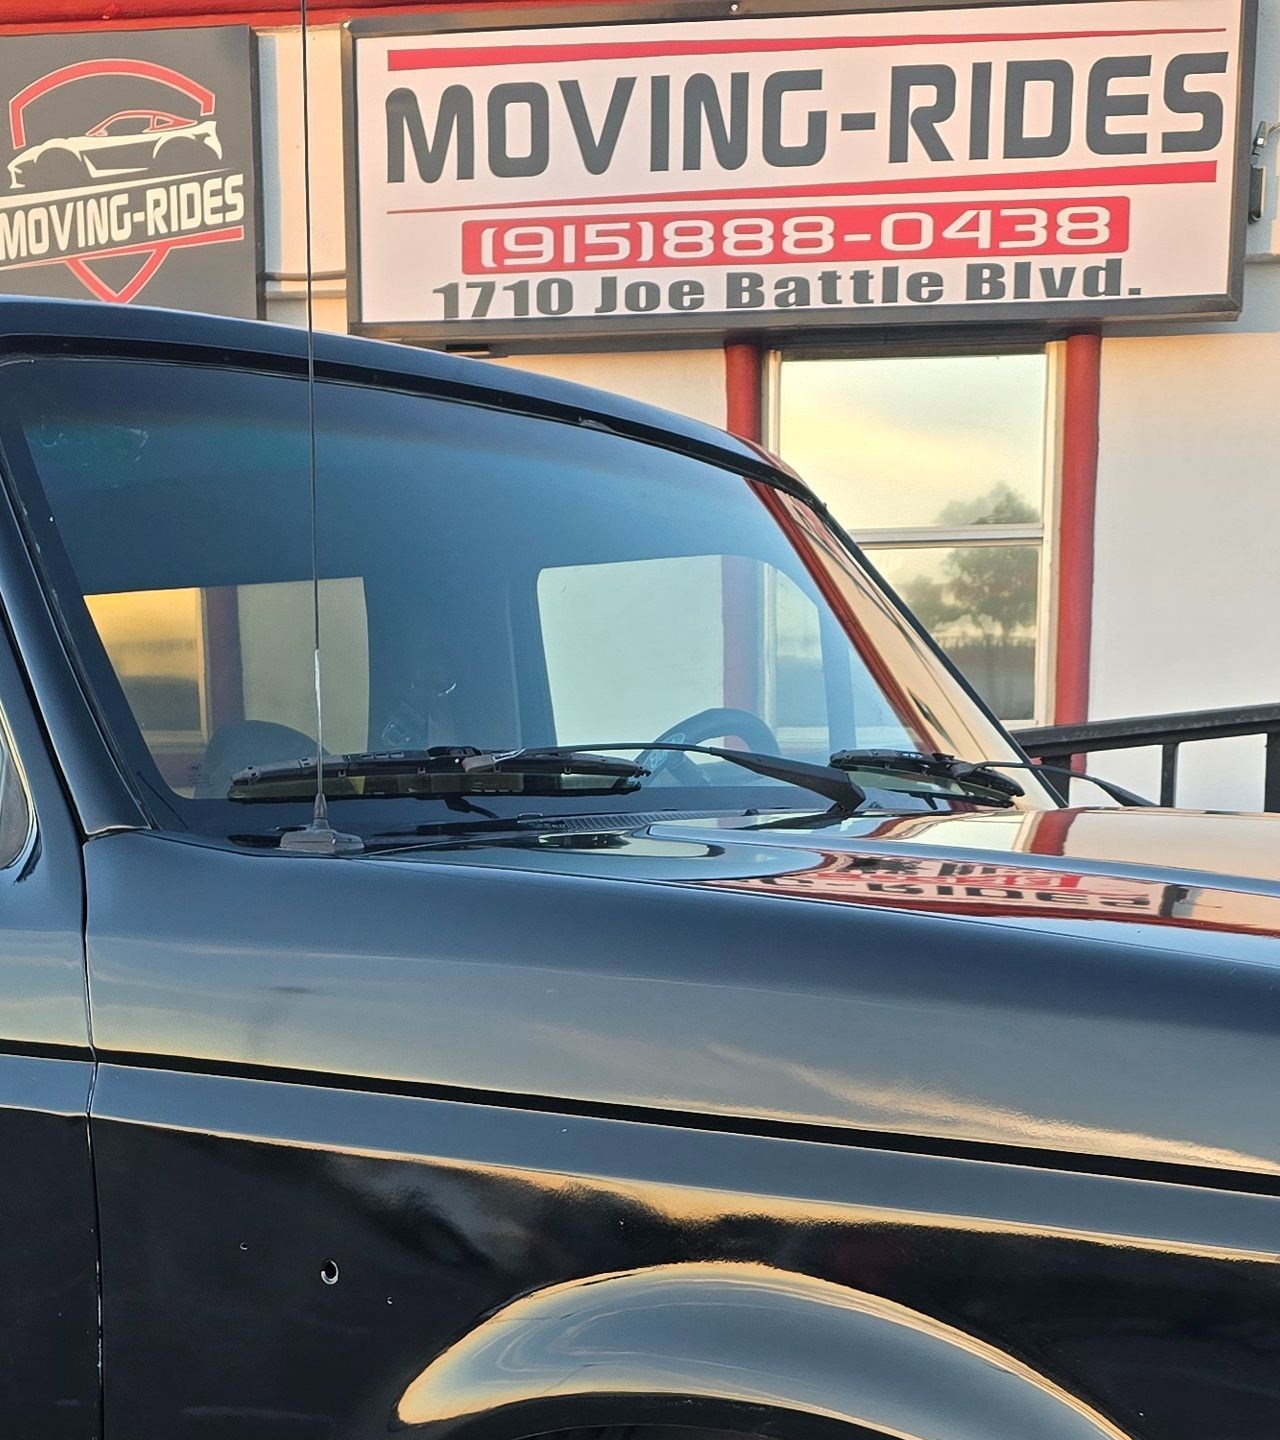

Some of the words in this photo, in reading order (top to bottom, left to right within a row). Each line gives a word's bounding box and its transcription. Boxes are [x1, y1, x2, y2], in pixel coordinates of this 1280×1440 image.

[385, 51, 1229, 184] MOVING-RIDES
[480, 207, 1112, 266] (915)888-0438
[431, 279, 574, 320] 1710
[593, 273, 706, 314] Joe
[725, 263, 946, 310] Battle
[964, 258, 1143, 304] Blvd.
